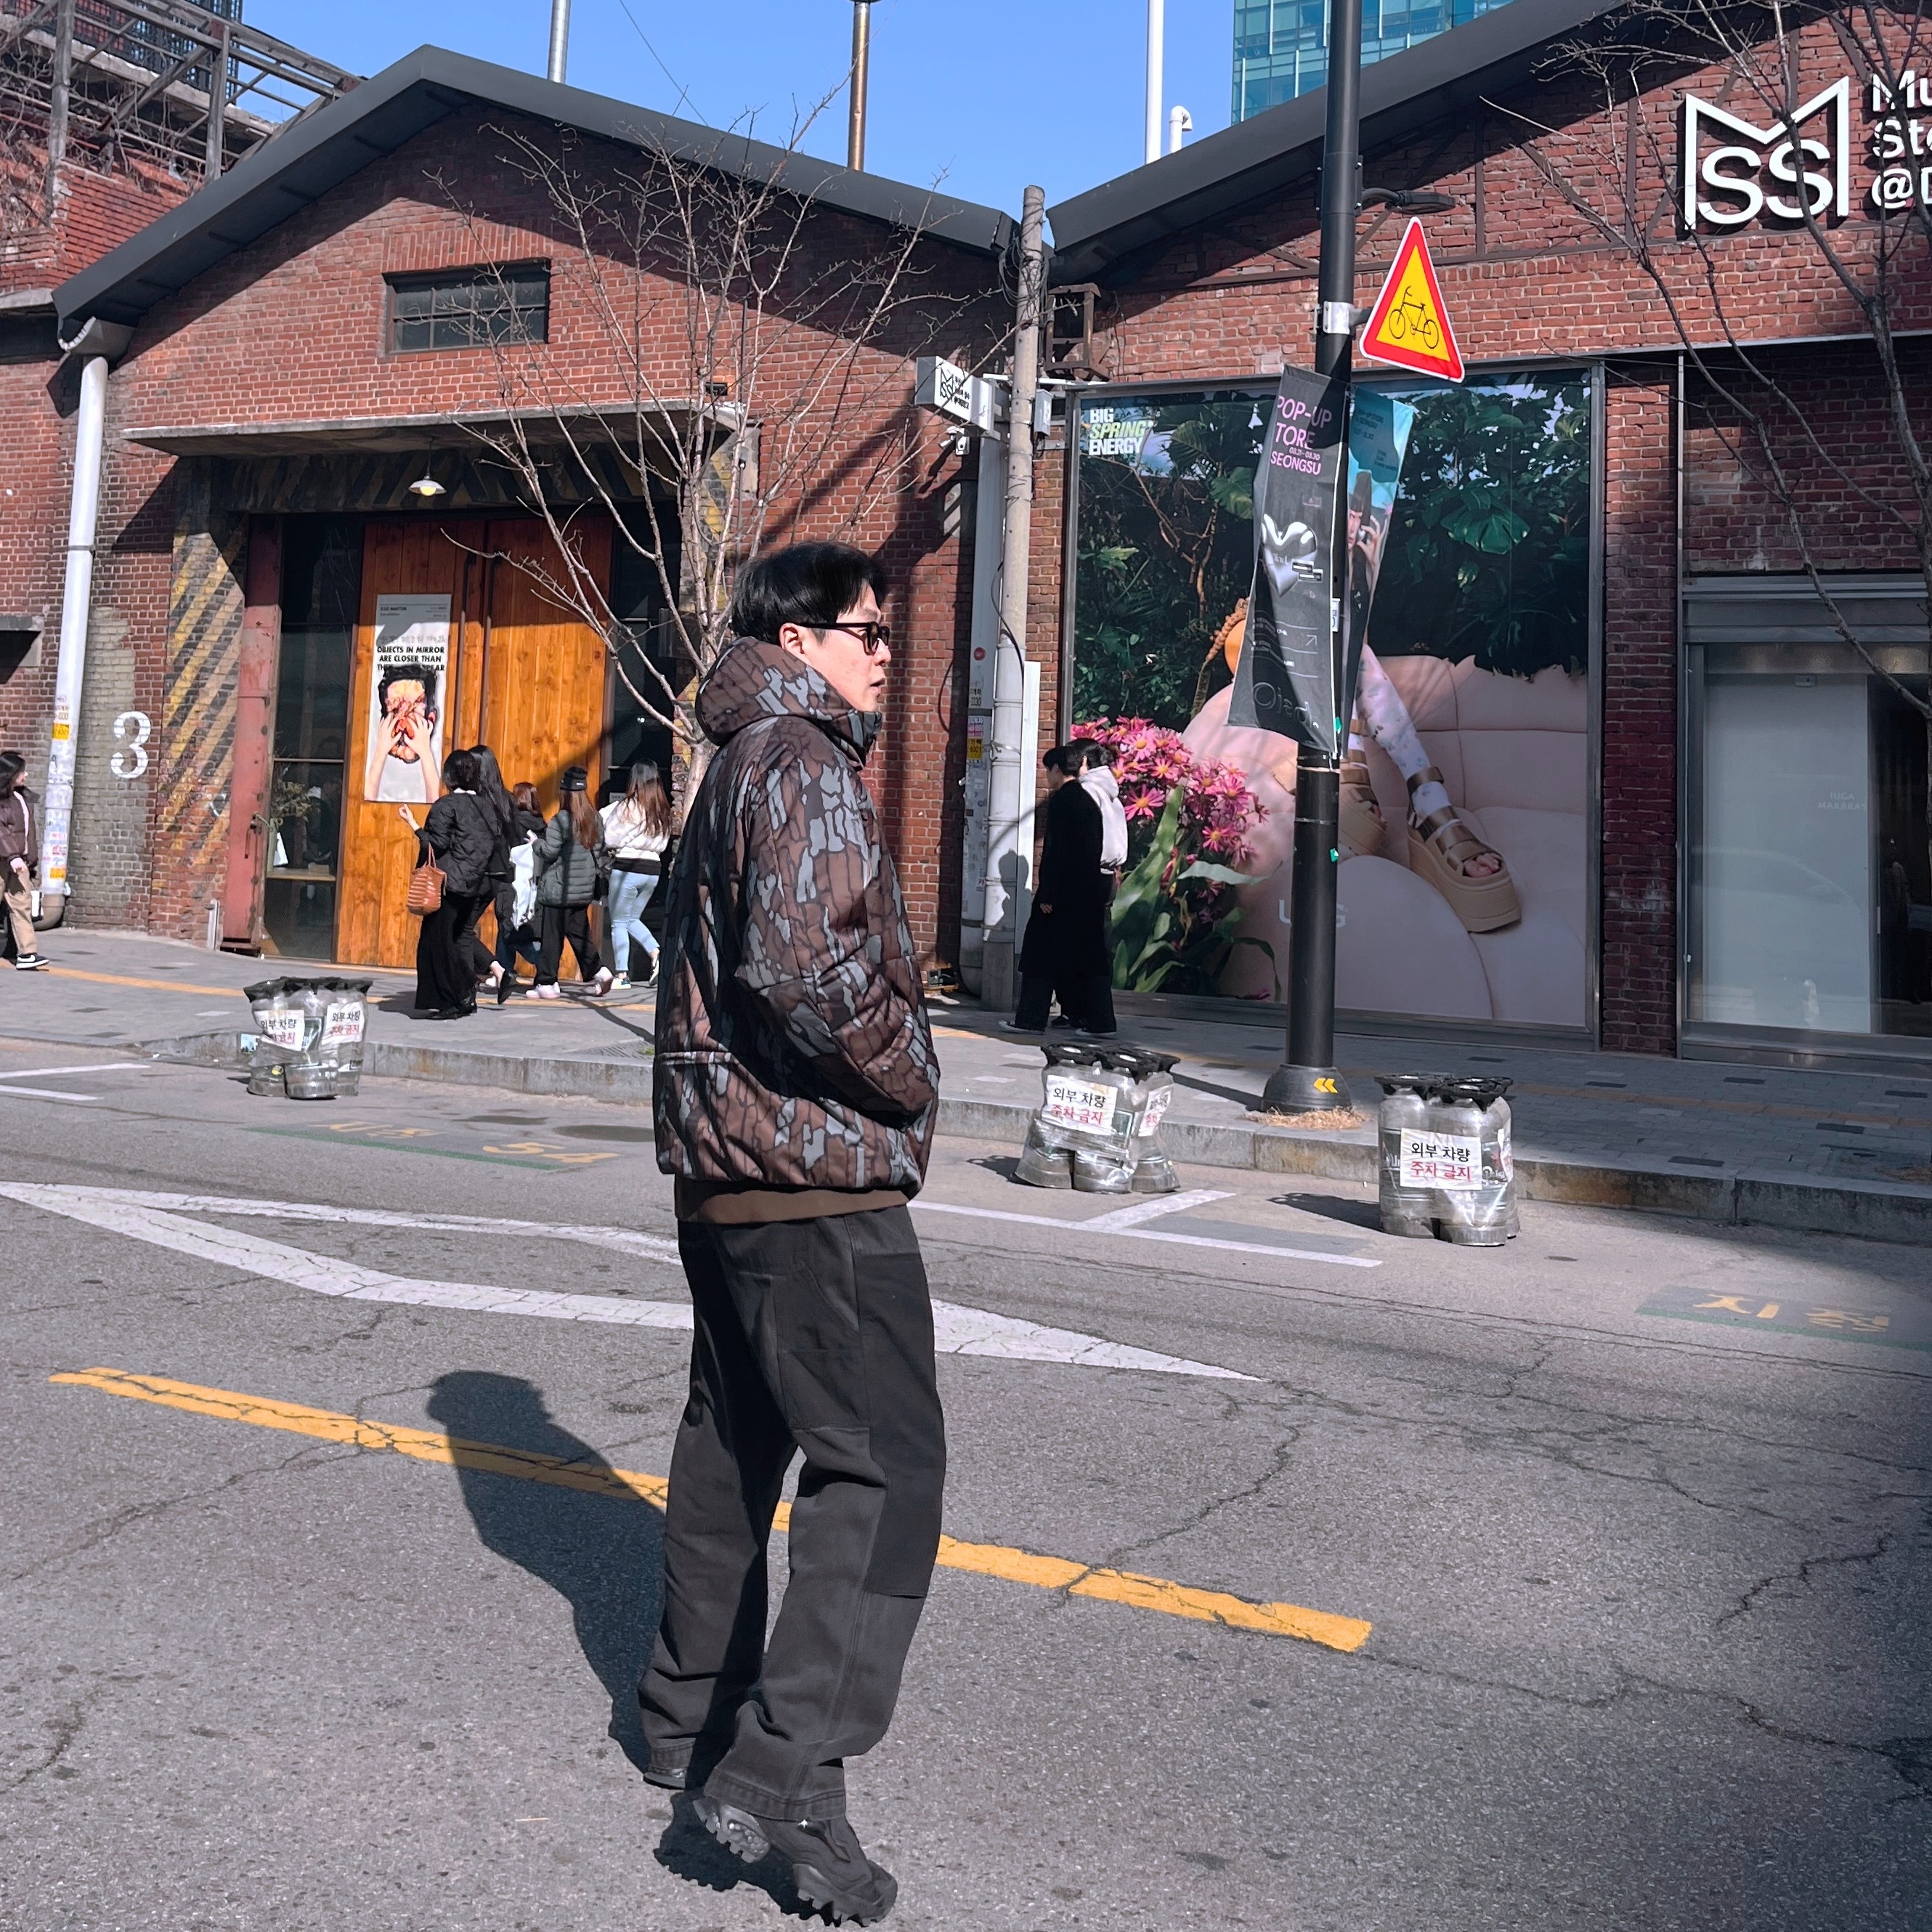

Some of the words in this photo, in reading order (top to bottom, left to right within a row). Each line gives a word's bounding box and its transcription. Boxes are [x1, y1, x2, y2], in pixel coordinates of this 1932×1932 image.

[1089, 407, 1114, 423] BIG
[1277, 395, 1333, 429] POP-UP
[1089, 421, 1147, 440] SPRING
[1275, 421, 1316, 450] TORE
[1088, 437, 1144, 455] ENERGY
[1270, 450, 1322, 476] SEONGSU
[110, 710, 152, 779] 3
[261, 1018, 277, 1030] 외부
[279, 1018, 297, 1029] 차량
[332, 1011, 346, 1022] 외부
[1053, 1087, 1077, 1103] 외부
[1081, 1092, 1106, 1108] 차량
[1051, 1104, 1074, 1119] 주차
[1079, 1109, 1103, 1125] 금지
[1411, 1142, 1437, 1158] 외부
[1442, 1146, 1471, 1162] 차량
[1411, 1161, 1438, 1178] 주차
[1443, 1164, 1472, 1182] 금지
